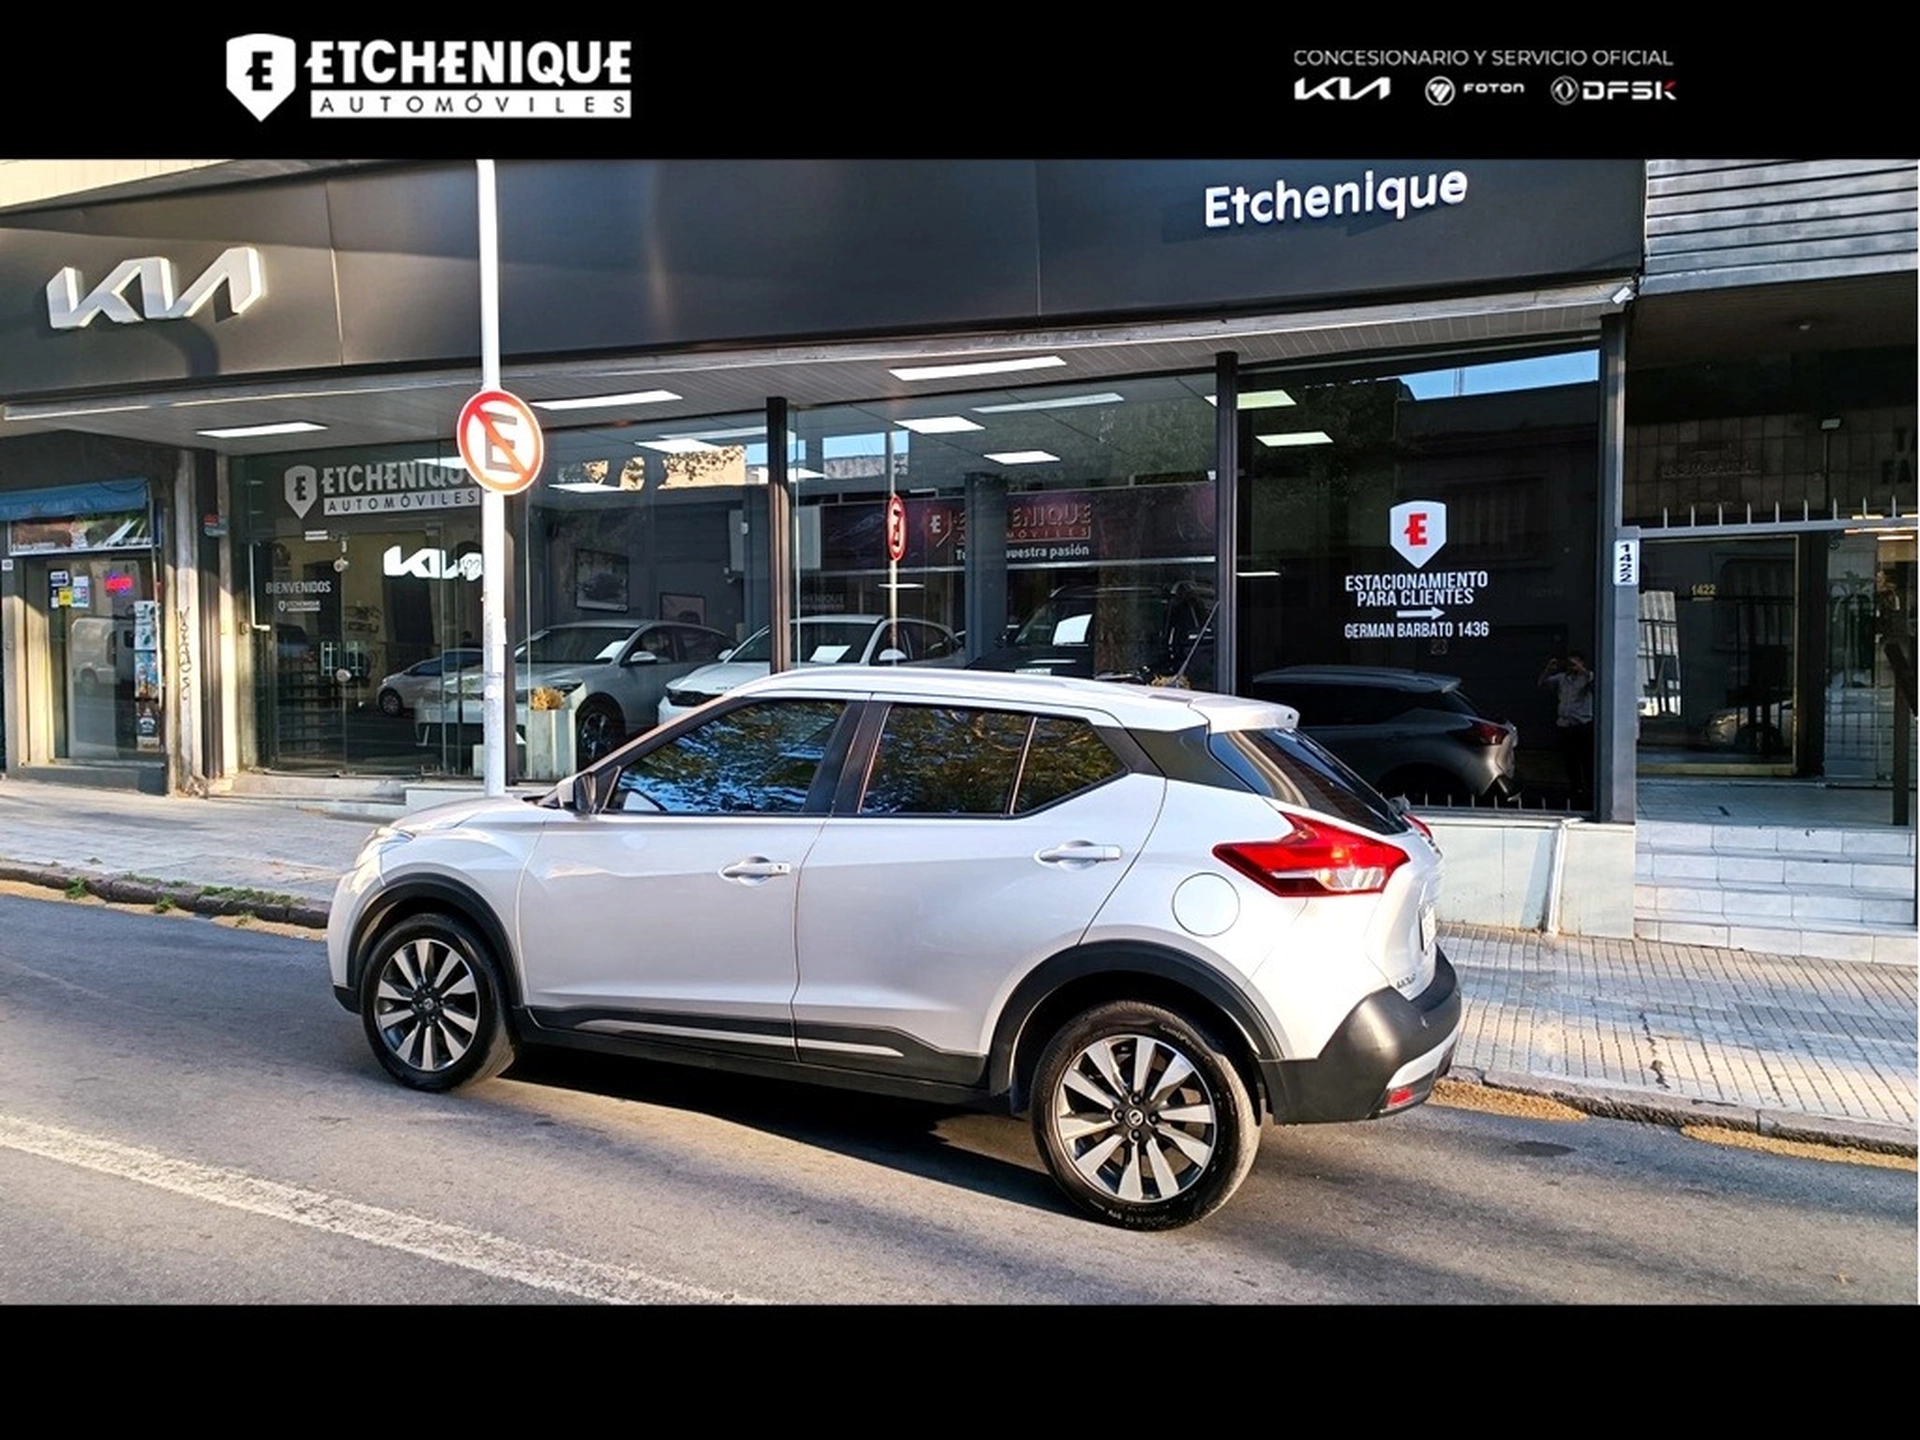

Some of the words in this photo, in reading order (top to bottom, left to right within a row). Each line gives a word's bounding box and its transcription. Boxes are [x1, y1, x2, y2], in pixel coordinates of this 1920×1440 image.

[1205, 170, 1468, 228] Etchenique
[46, 247, 266, 329] KIA
[484, 410, 520, 473] E
[327, 491, 475, 513] AUTOMÓVILES
[1049, 543, 1090, 559] pasión
[1619, 543, 1632, 583] 1422
[265, 580, 332, 595] BIENVENIDOS
[1345, 571, 1488, 591] ESTACIONAMIENTO
[1690, 584, 1716, 596] 1422
[1357, 590, 1397, 606] PARA
[1401, 588, 1474, 606] CLIENTES
[1344, 623, 1394, 638] GERMAN
[1397, 622, 1454, 638] BARBATO
[1458, 621, 1489, 637] 1436
